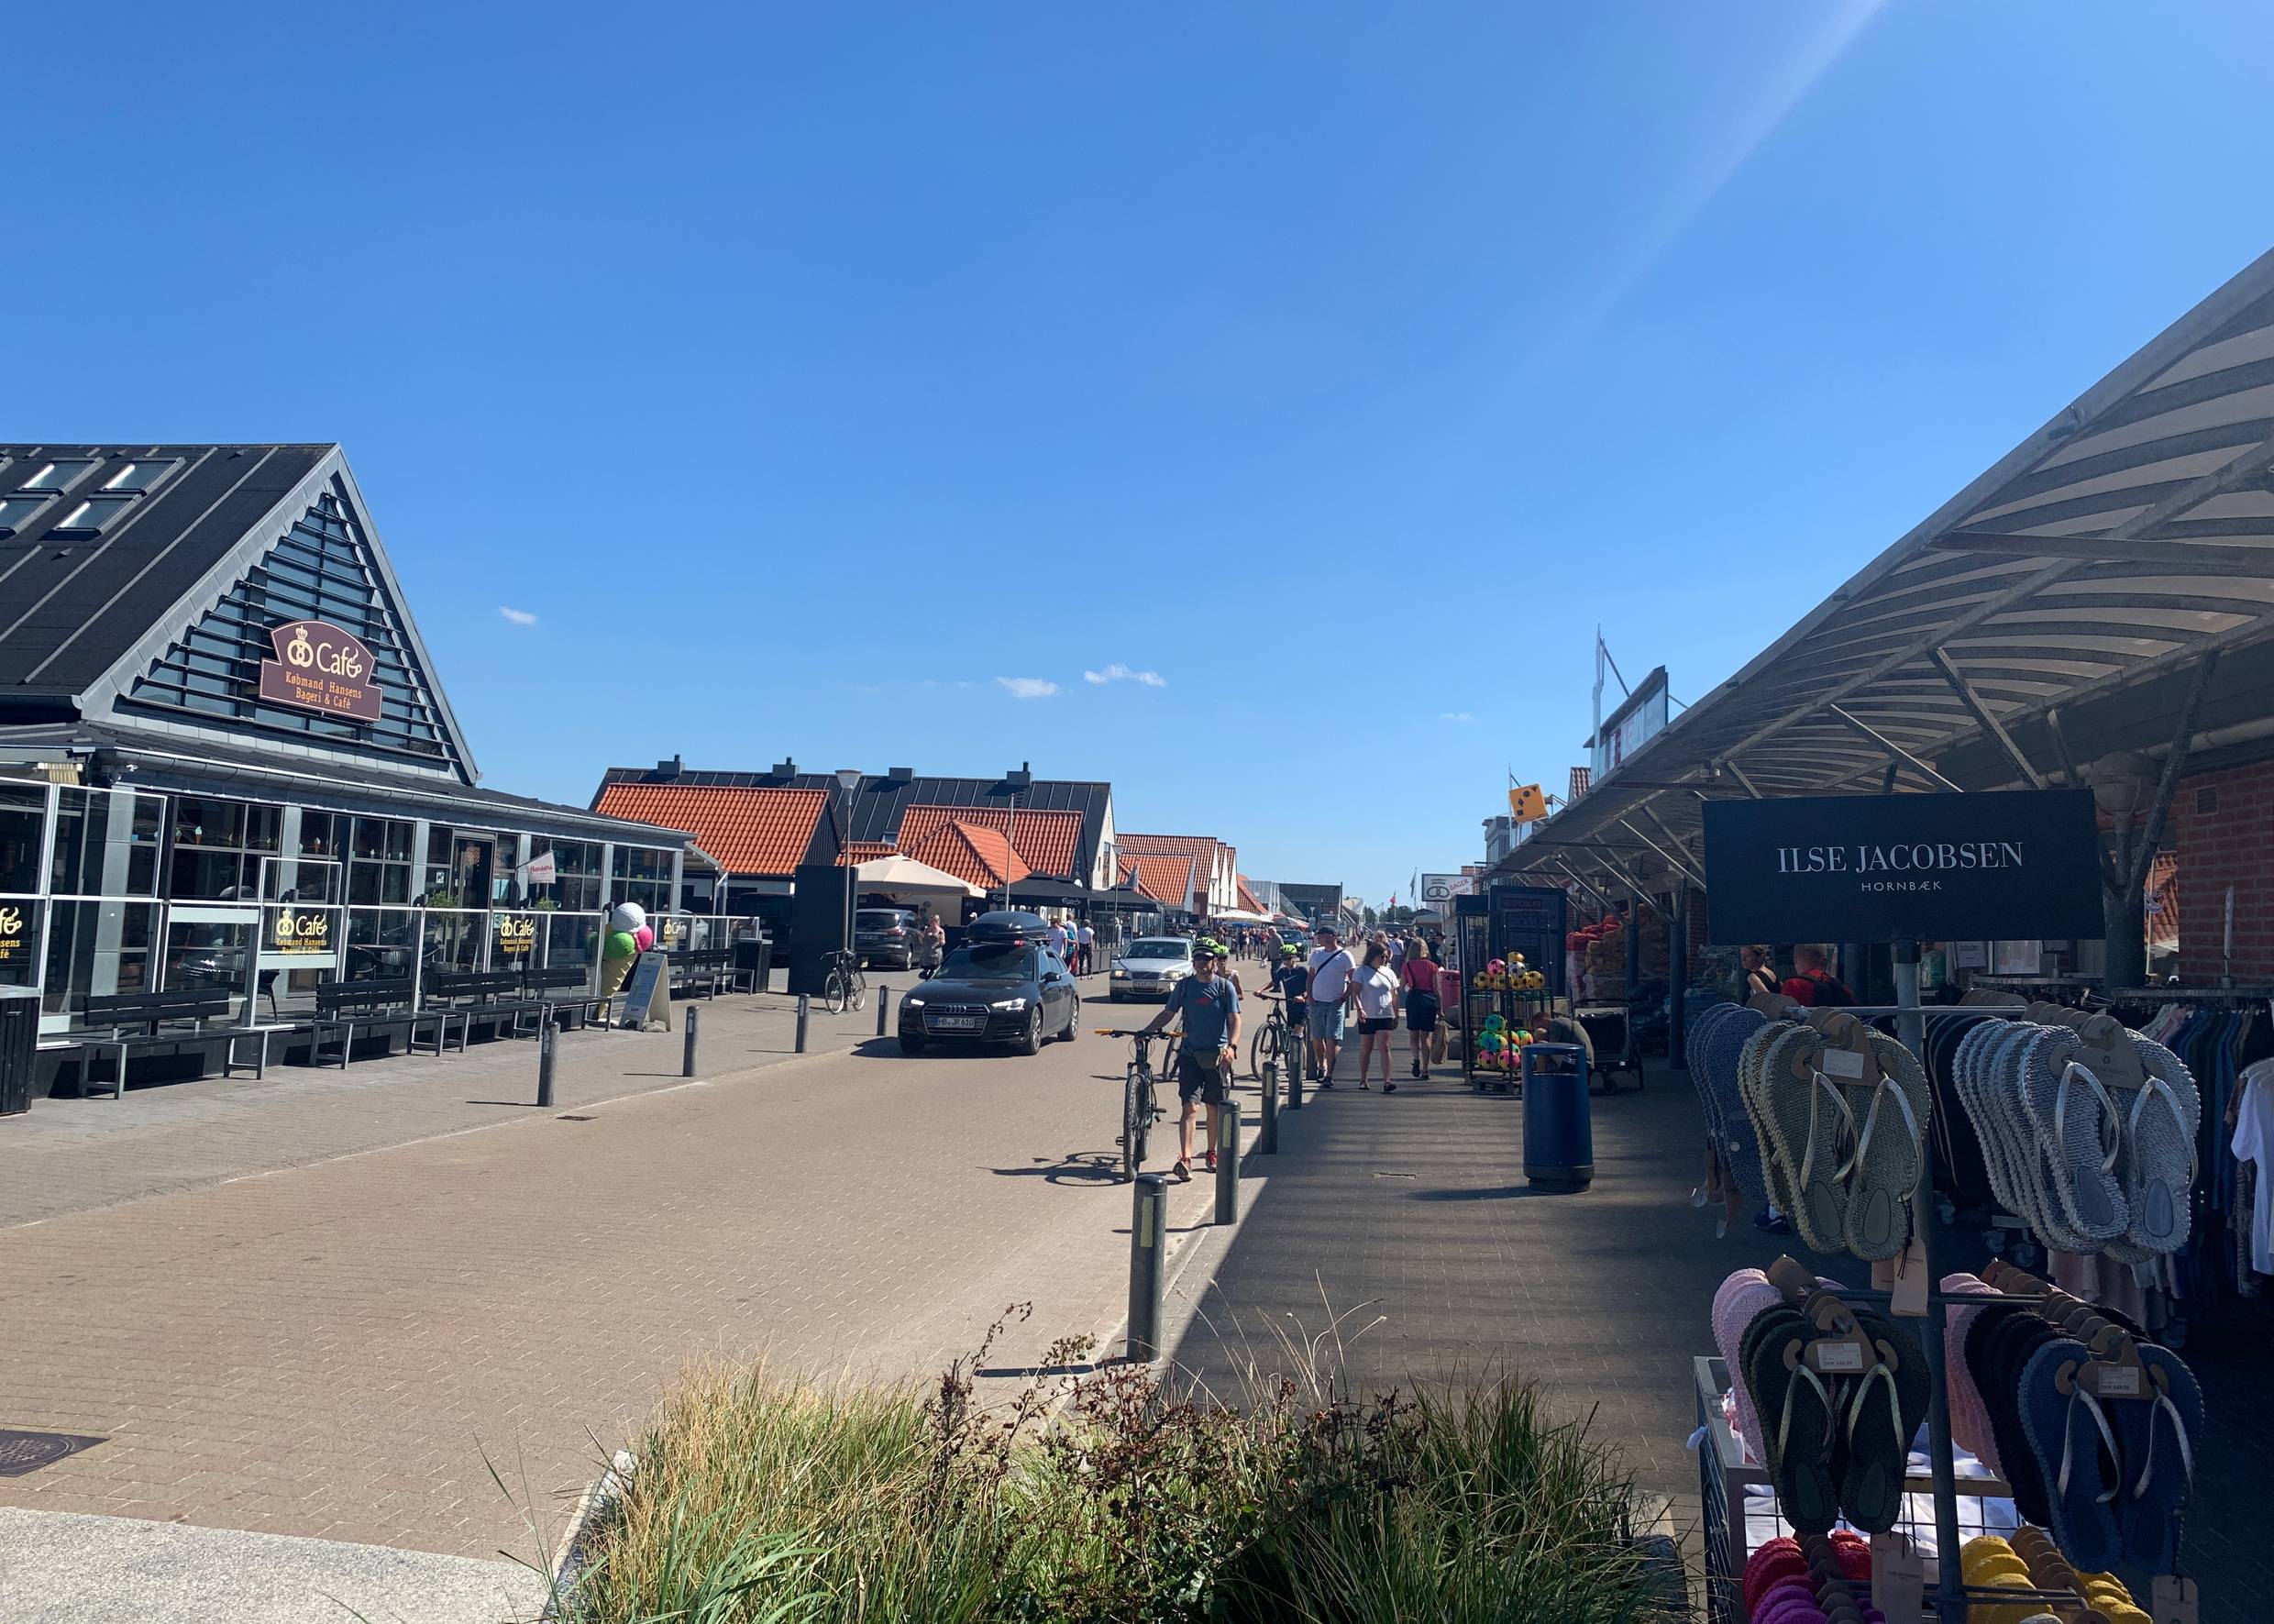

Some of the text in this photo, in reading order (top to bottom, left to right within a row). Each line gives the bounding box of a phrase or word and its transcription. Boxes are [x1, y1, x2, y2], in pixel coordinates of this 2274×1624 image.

[317, 642, 362, 678] Café
[285, 670, 362, 699] Købmand Hansens
[295, 688, 351, 709] Bageri & Café
[1777, 842, 2024, 873] ILSE JACOBSEN
[1861, 880, 1943, 892] HORNBÆK
[0, 906, 22, 934] fé
[295, 914, 328, 935] Café
[513, 919, 535, 936] Café
